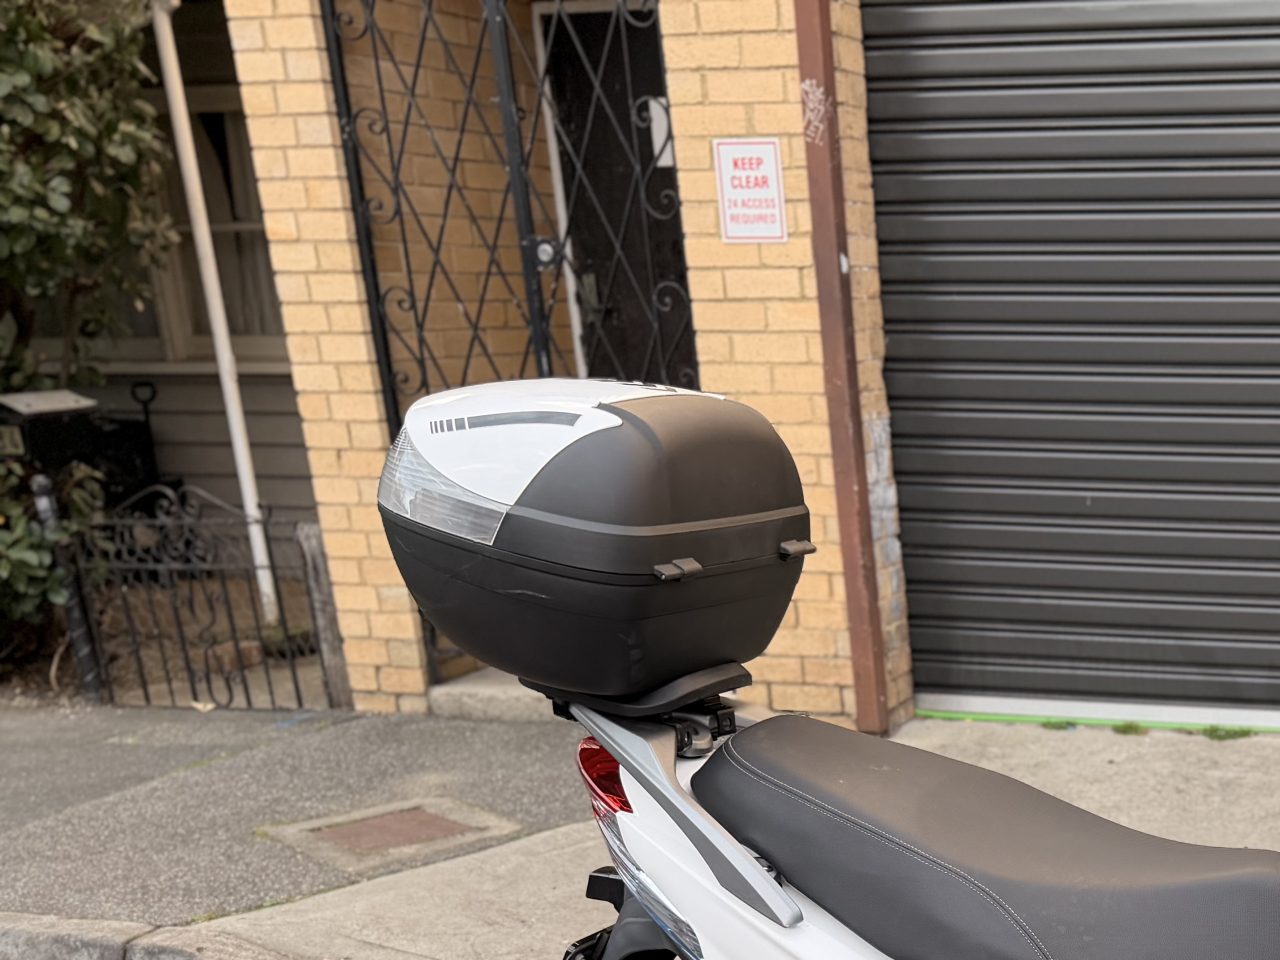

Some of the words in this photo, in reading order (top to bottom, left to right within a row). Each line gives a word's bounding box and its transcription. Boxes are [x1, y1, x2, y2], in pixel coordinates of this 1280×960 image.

[731, 156, 764, 172] KEEP
[730, 175, 770, 190] CLEAR
[741, 197, 777, 210] ACCESS
[729, 212, 778, 225] REQUIRED
